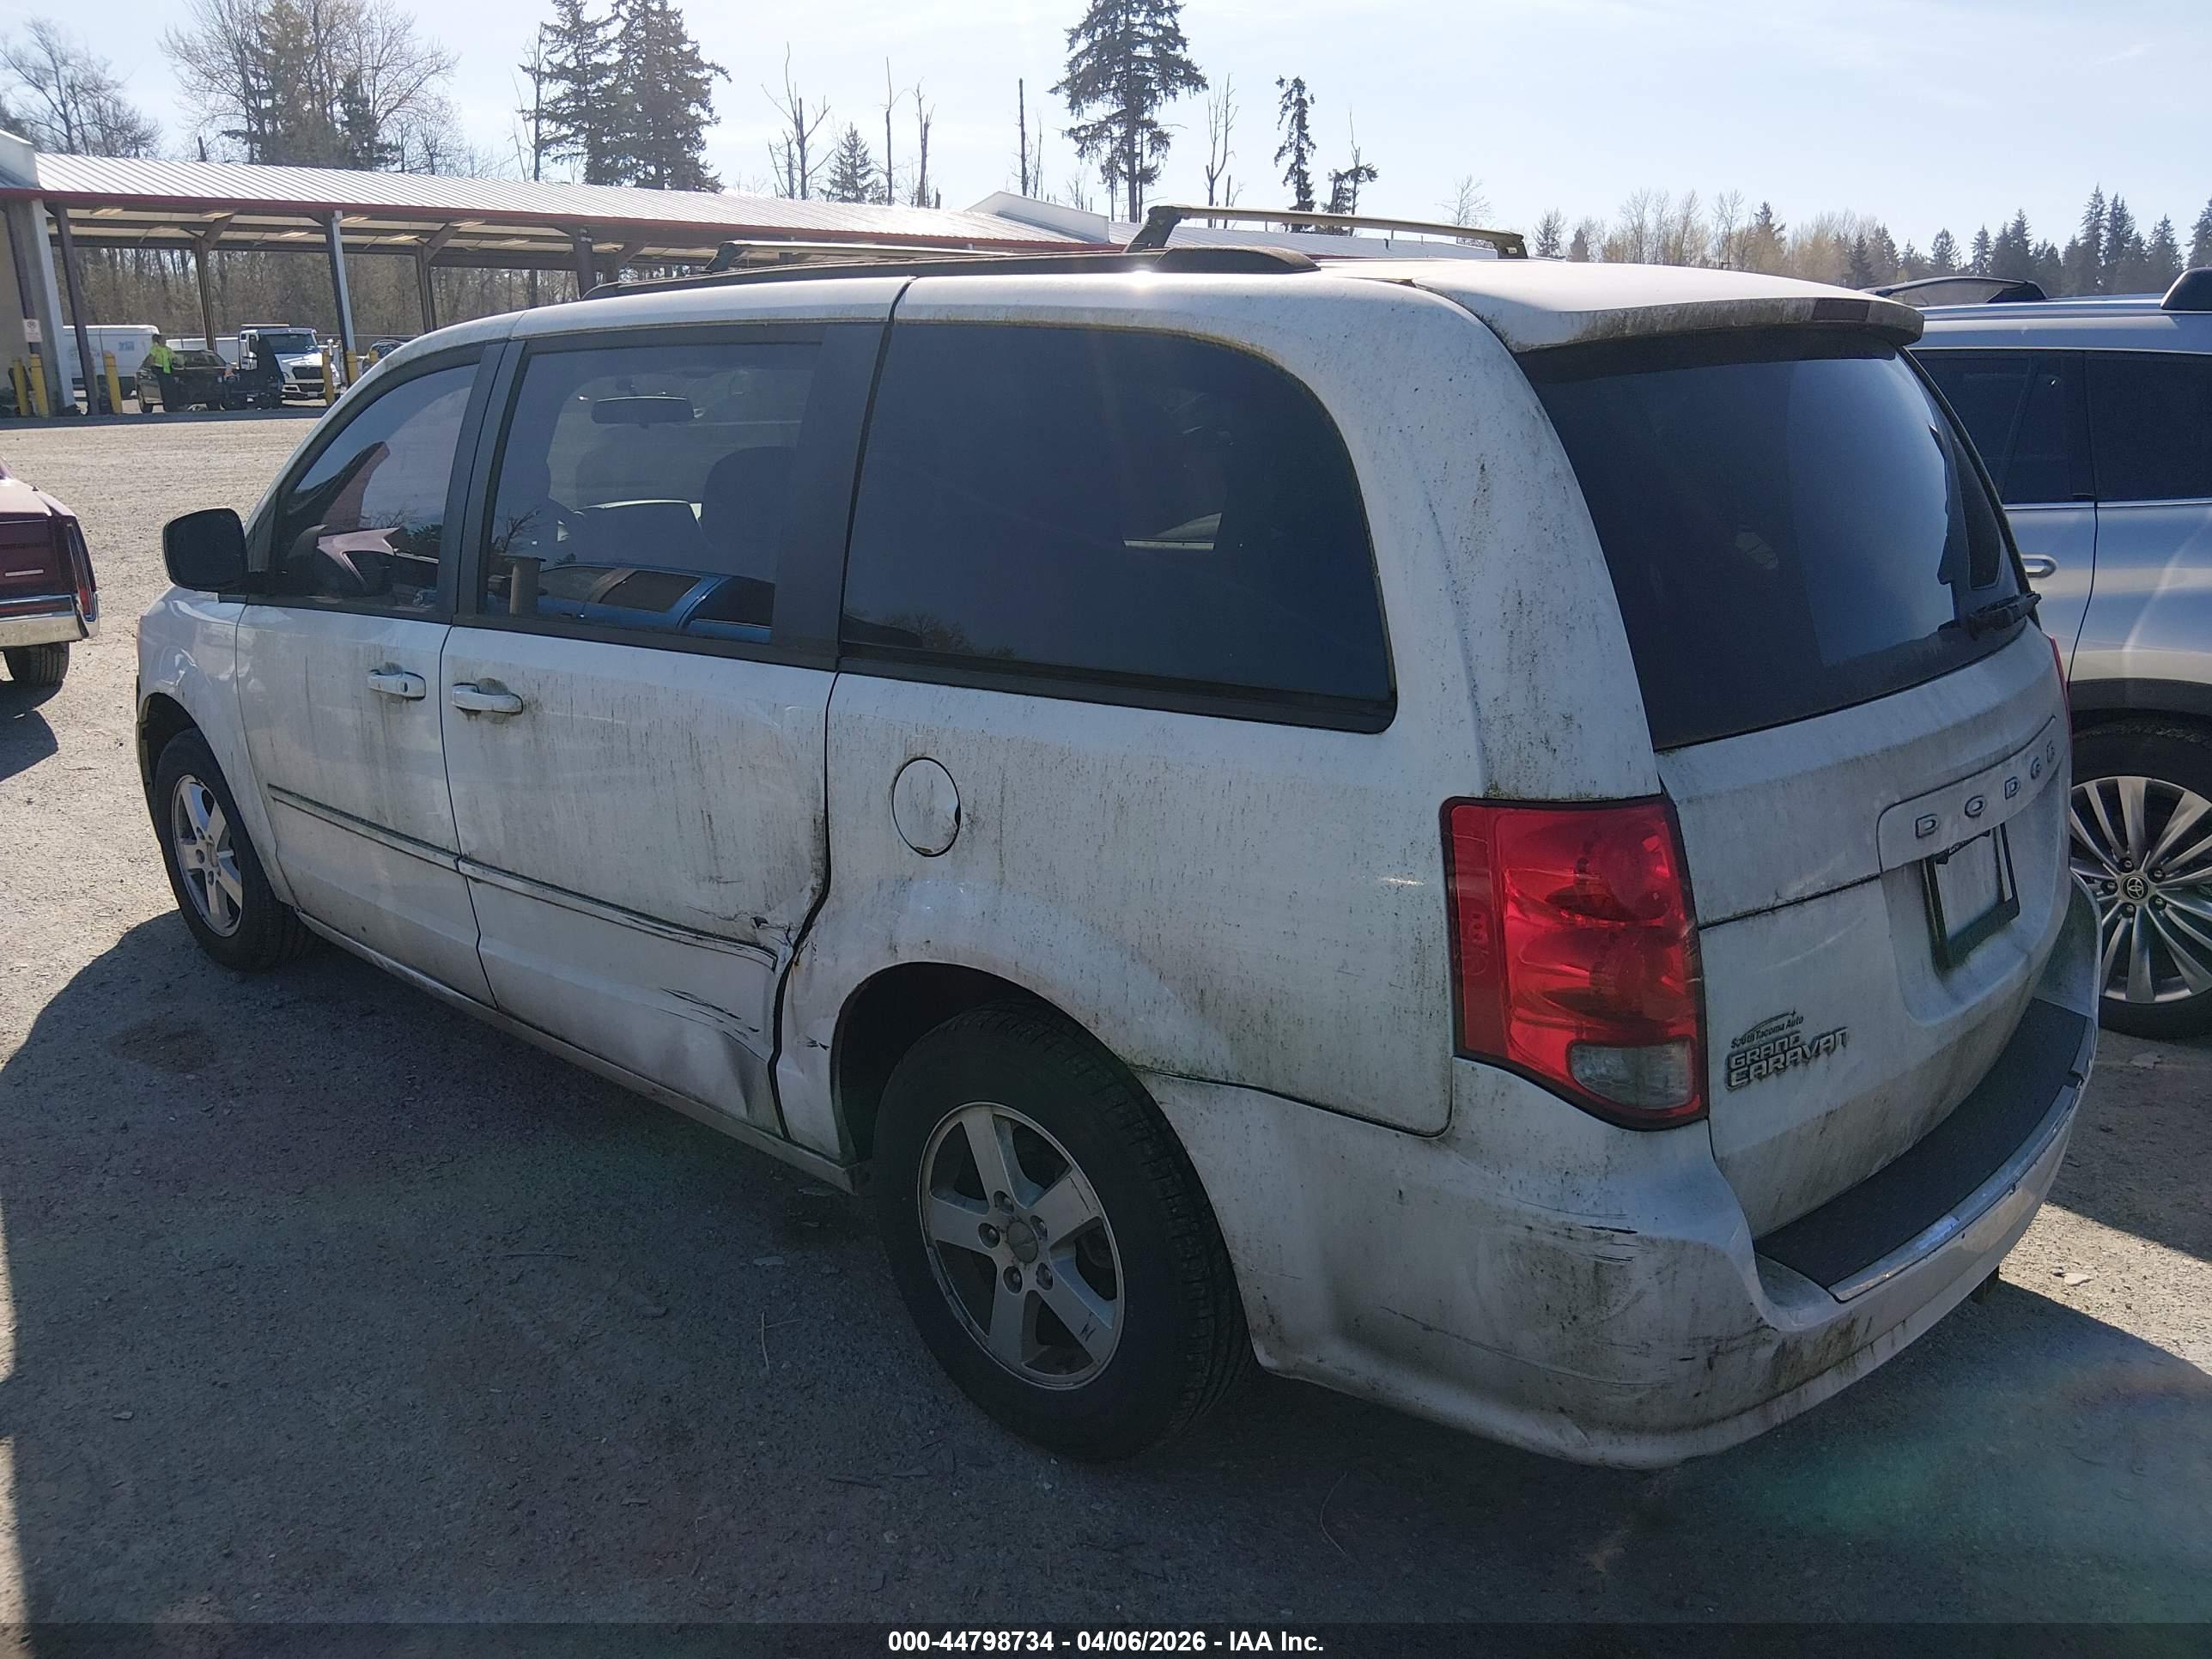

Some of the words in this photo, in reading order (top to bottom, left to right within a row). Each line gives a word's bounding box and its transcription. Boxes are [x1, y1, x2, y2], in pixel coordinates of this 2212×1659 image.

[1729, 1032, 1802, 1070] GRAND
[1731, 1035, 1755, 1048] South
[1755, 1024, 1785, 1040] Tacoma
[1785, 1016, 1804, 1030] Auto
[1728, 1028, 1848, 1089] CARAVAN
